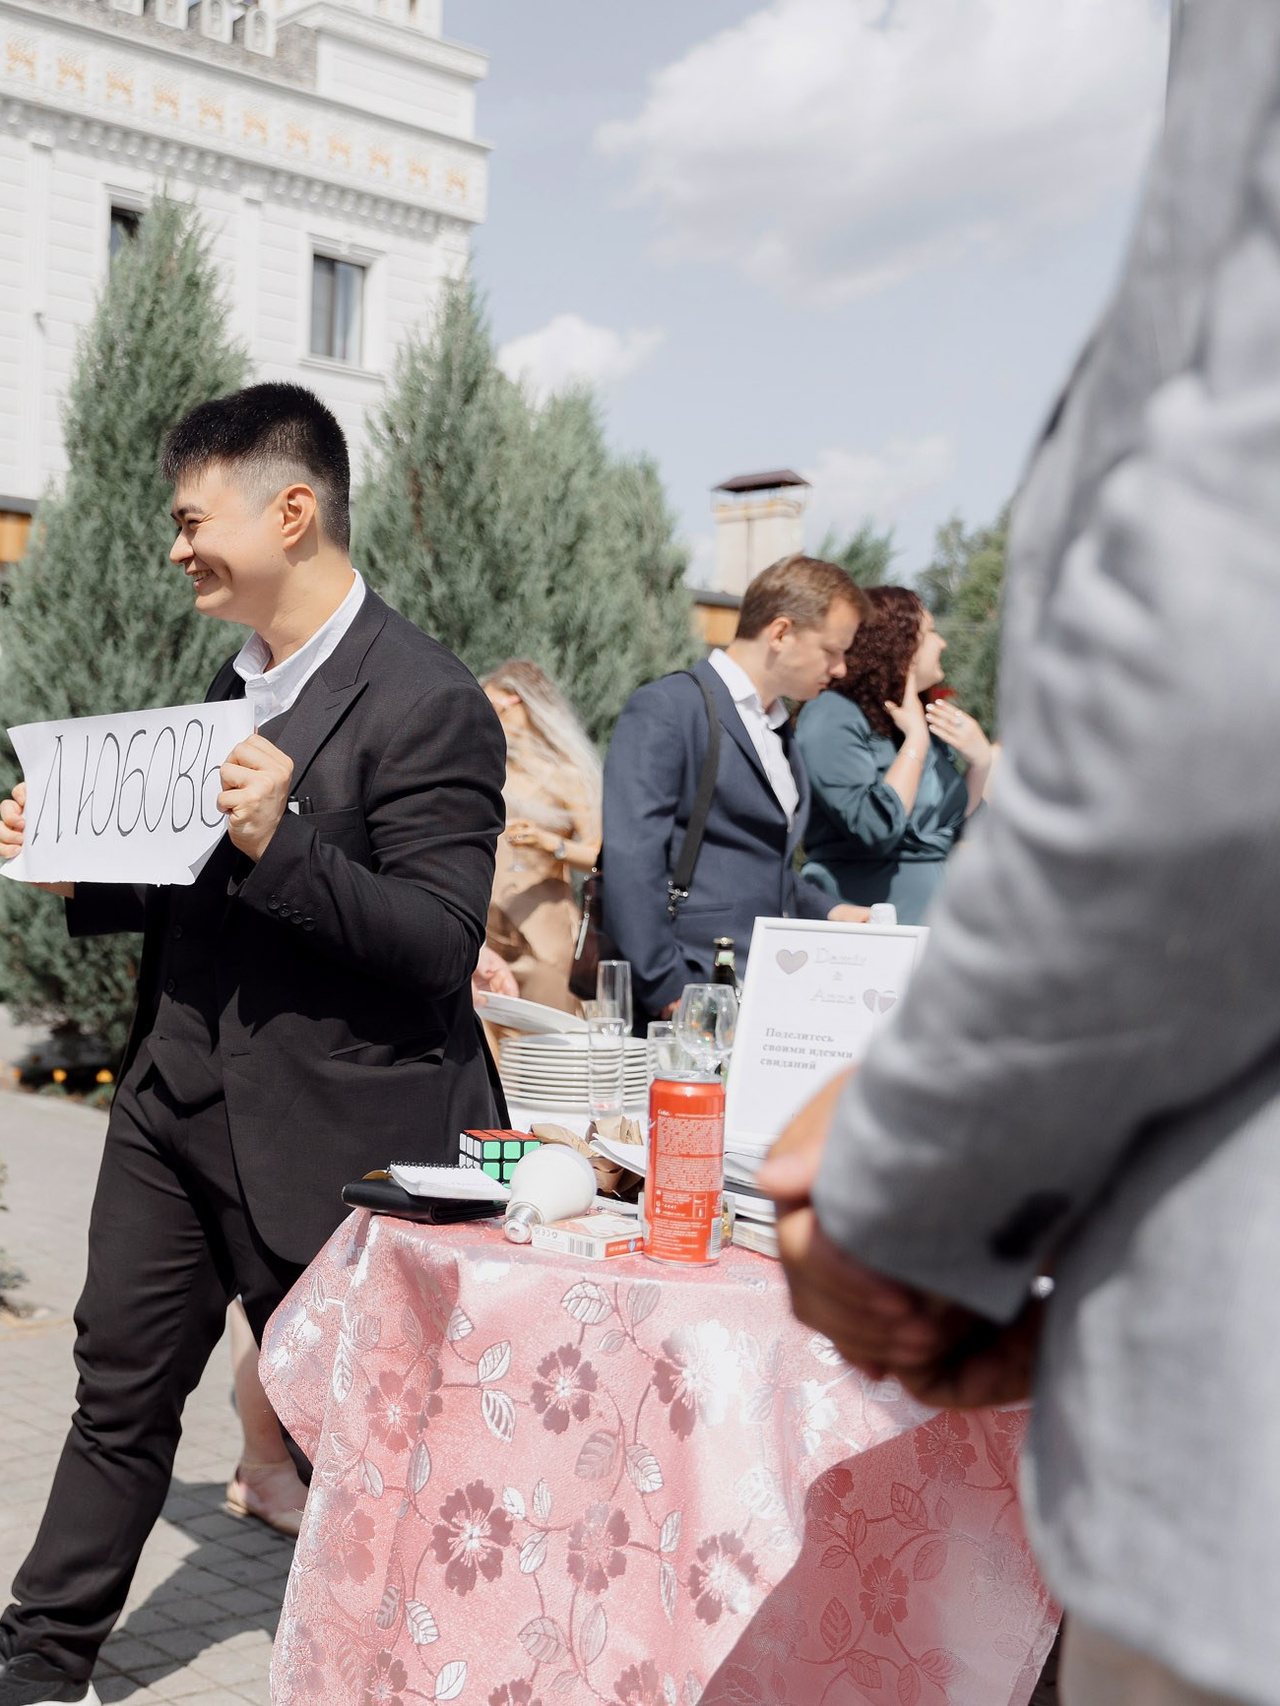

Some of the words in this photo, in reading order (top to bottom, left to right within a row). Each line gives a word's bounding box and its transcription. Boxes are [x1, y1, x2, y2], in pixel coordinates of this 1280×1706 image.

[765, 1027, 835, 1042] Поделитесь
[762, 1043, 806, 1055] своими
[809, 1048, 853, 1059] идеями
[760, 1058, 816, 1070] свиданий
